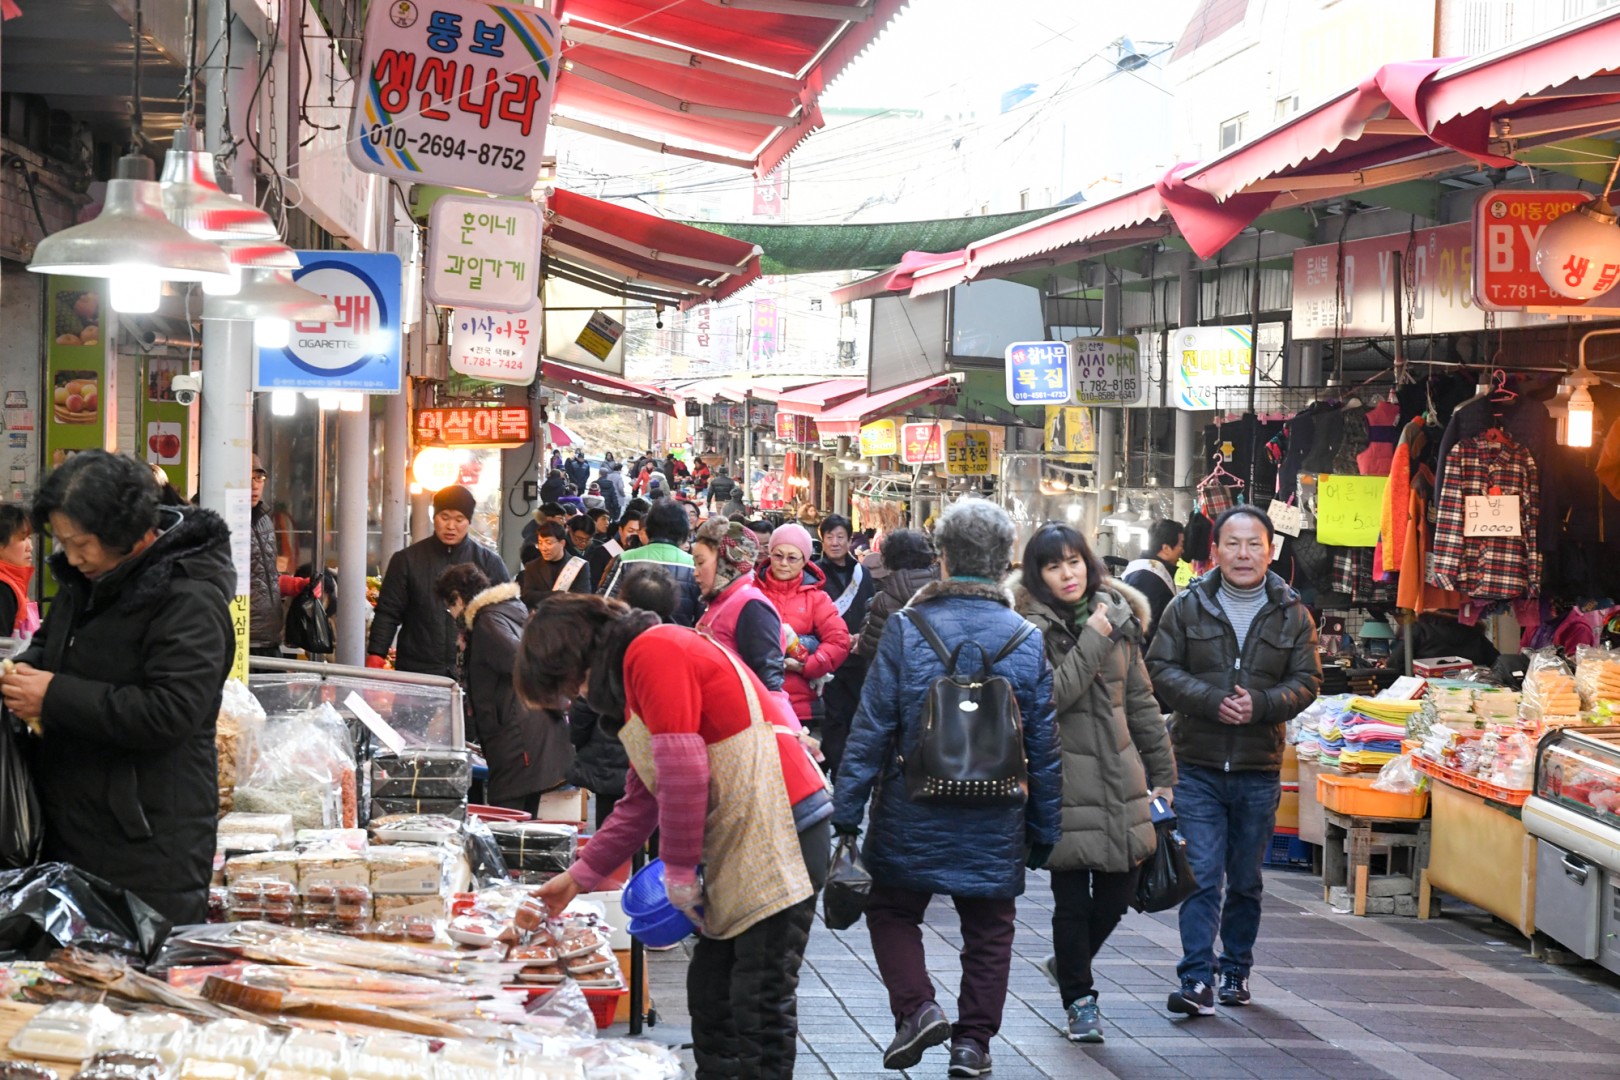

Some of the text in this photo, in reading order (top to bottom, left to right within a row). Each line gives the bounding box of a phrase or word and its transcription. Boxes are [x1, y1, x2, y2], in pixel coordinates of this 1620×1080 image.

[427, 10, 505, 57] 뚱보
[375, 49, 541, 136] 생선나라
[370, 124, 526, 171] 010-2694-8752
[461, 212, 516, 245] 훈이네
[444, 255, 525, 289] 과일가게
[296, 295, 371, 335] 배
[461, 315, 530, 346] 이삭어묵
[462, 355, 524, 370] T.784-7424
[1078, 353, 1136, 379] 싱싱야채
[418, 409, 528, 440] 이삭어묵
[1472, 524, 1514, 533] 10000
